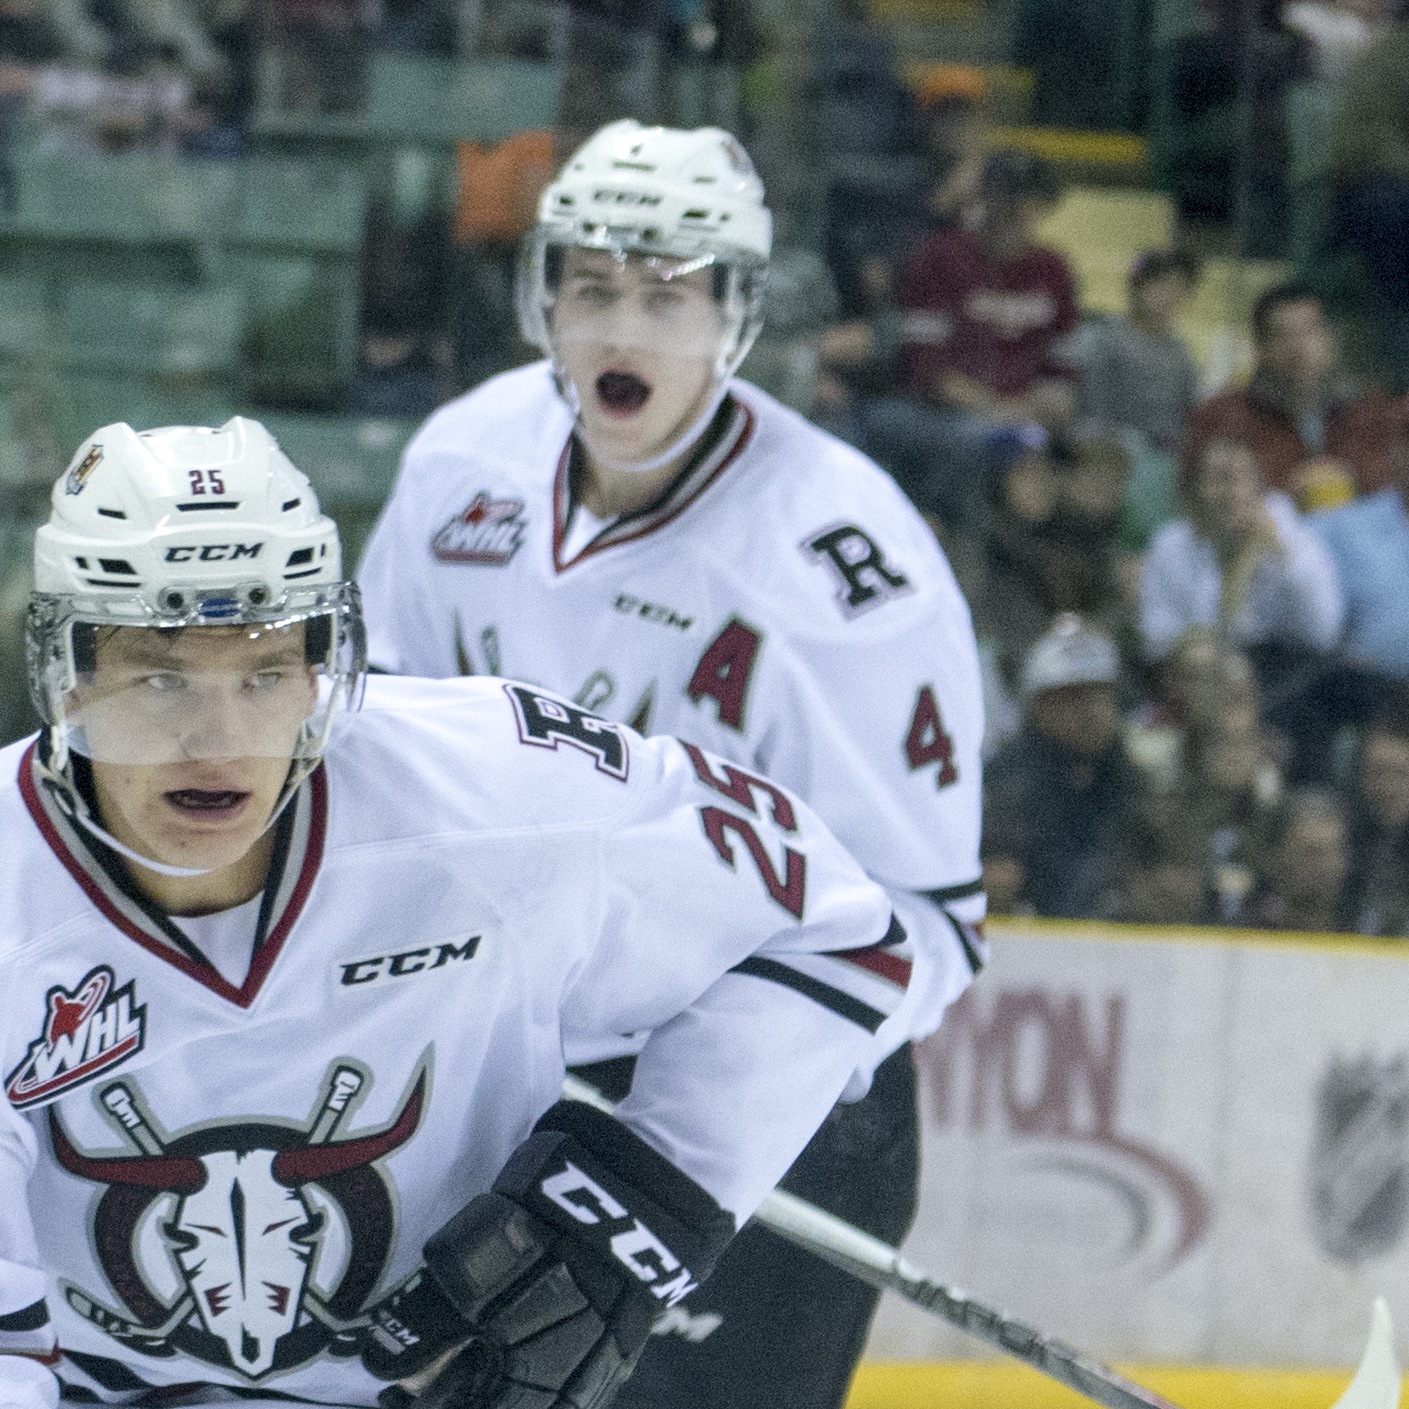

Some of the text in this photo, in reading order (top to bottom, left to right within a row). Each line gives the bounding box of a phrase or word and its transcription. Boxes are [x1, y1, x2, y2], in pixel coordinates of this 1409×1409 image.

[188, 469, 226, 496] 25
[164, 542, 265, 563] CCM
[797, 521, 916, 622] R
[682, 614, 765, 734] A
[900, 684, 959, 790] 4
[675, 736, 808, 924] 25
[338, 934, 483, 986] CCM
[34, 993, 141, 1085] WHL
[541, 1160, 699, 1308] CCM
